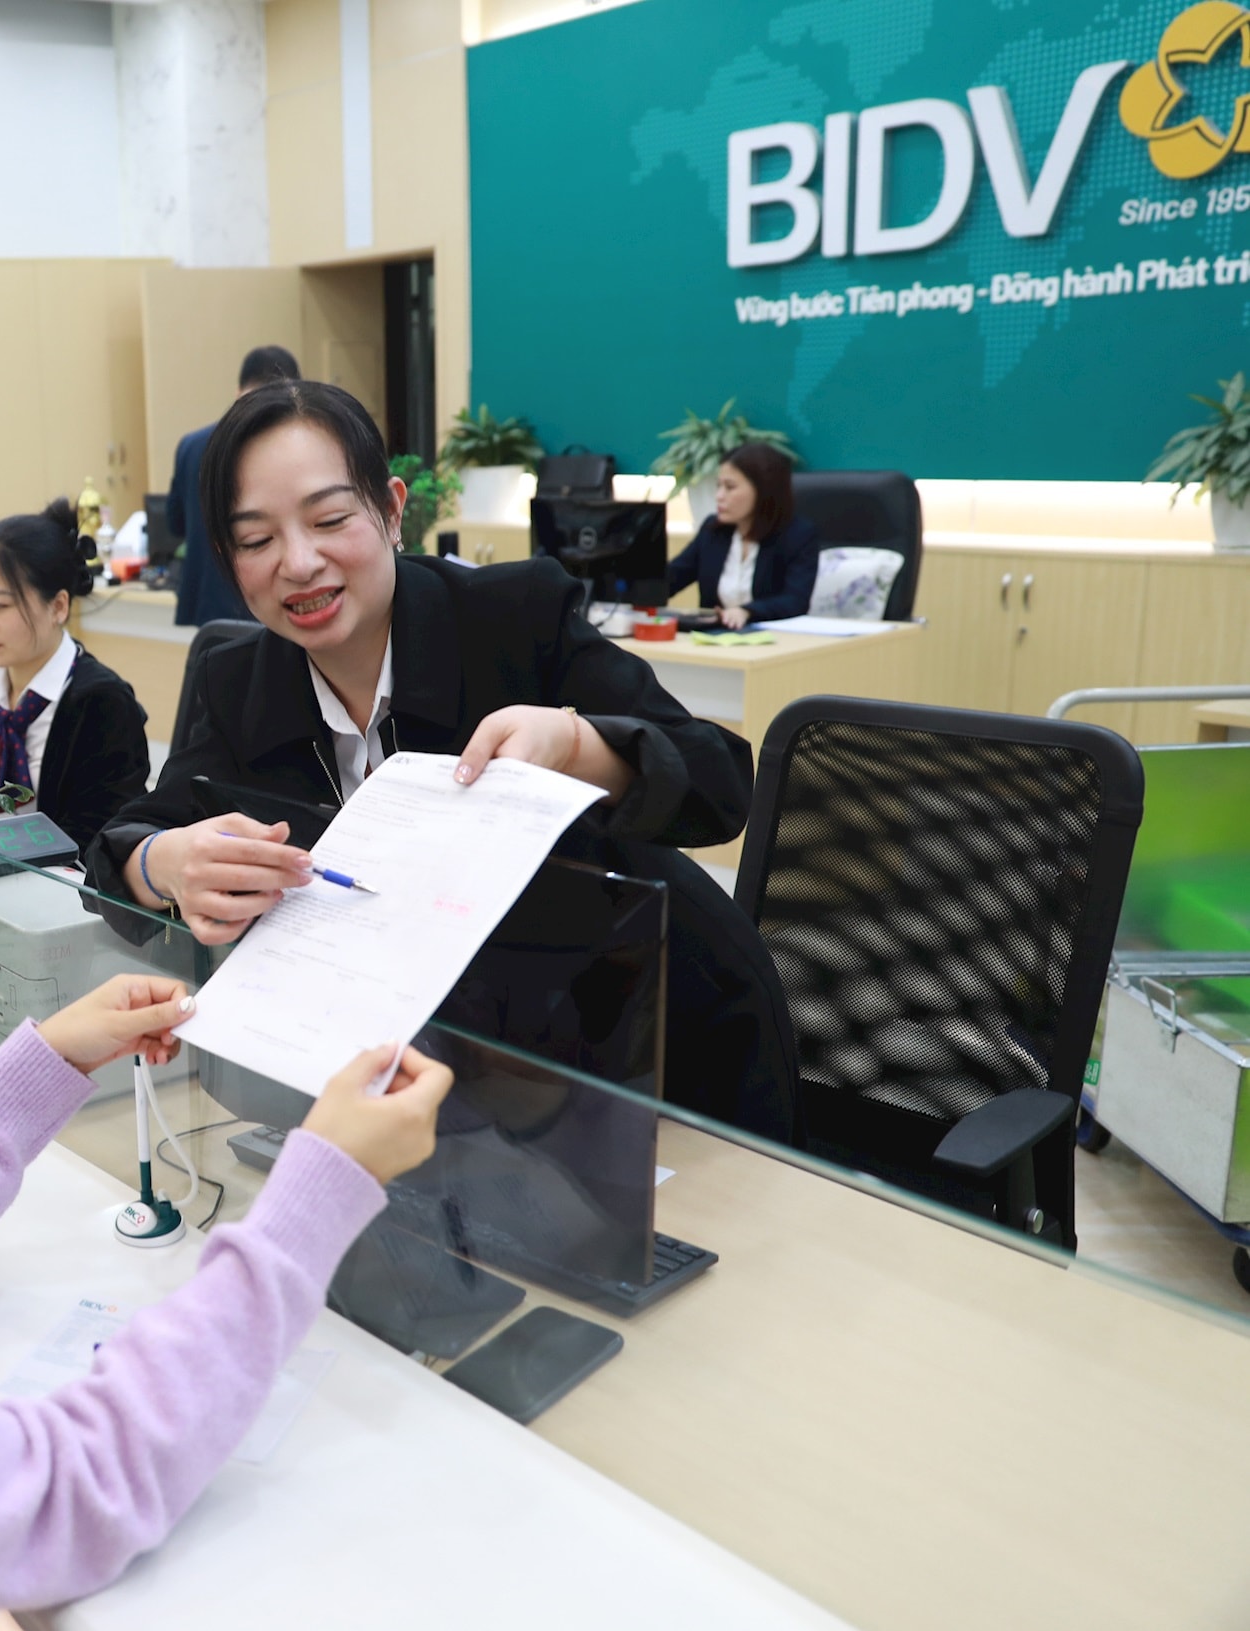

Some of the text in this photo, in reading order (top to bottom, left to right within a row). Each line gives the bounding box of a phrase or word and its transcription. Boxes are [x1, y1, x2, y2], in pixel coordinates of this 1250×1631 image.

[727, 59, 1129, 268] BIDV
[1119, 198, 1198, 225] Since
[896, 281, 974, 317] phong
[1136, 256, 1209, 292] Phát
[1213, 249, 1250, 285] tri
